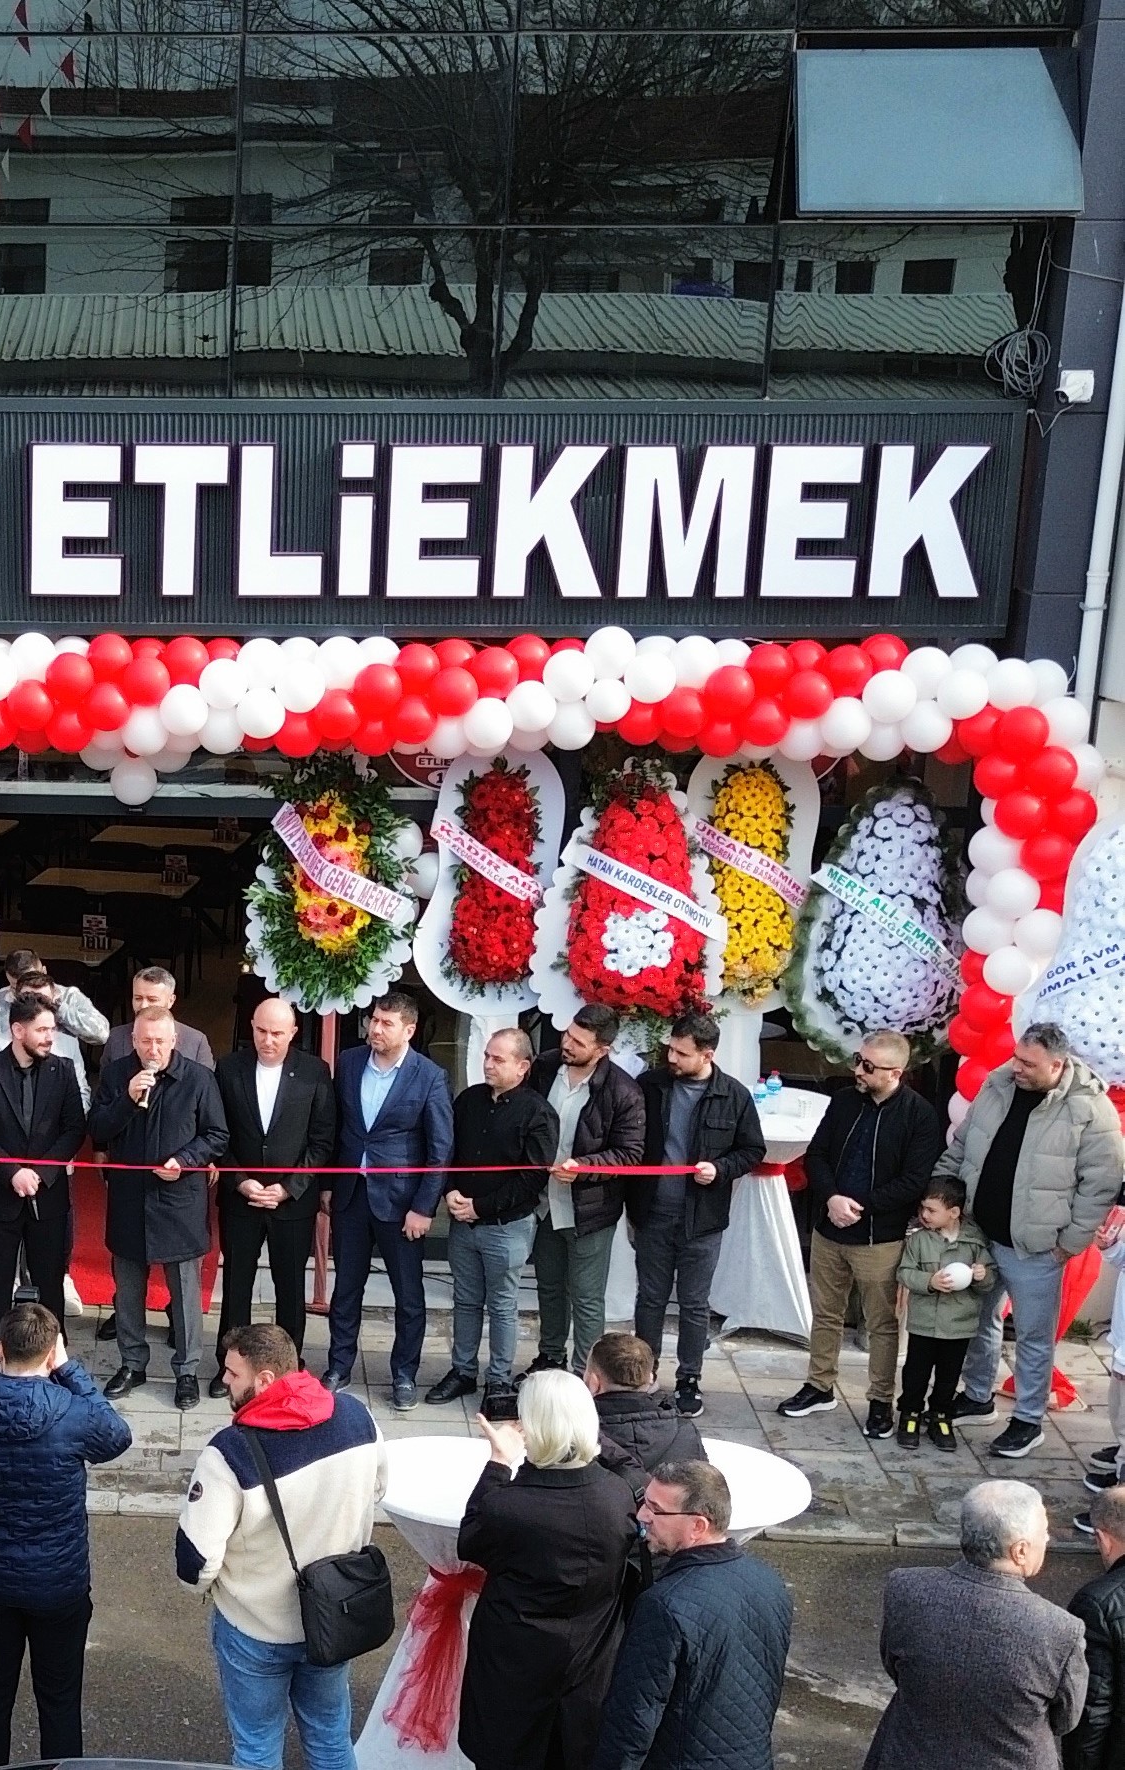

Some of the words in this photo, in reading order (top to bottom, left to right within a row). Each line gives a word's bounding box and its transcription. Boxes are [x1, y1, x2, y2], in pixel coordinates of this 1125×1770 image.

[323, 867, 361, 900] GENEL
[586, 853, 615, 877] HATAN
[613, 868, 673, 905] KARDEŞLER
[826, 867, 869, 898] MERT
[901, 920, 945, 958] EMRE
[1082, 943, 1120, 965] AVM
